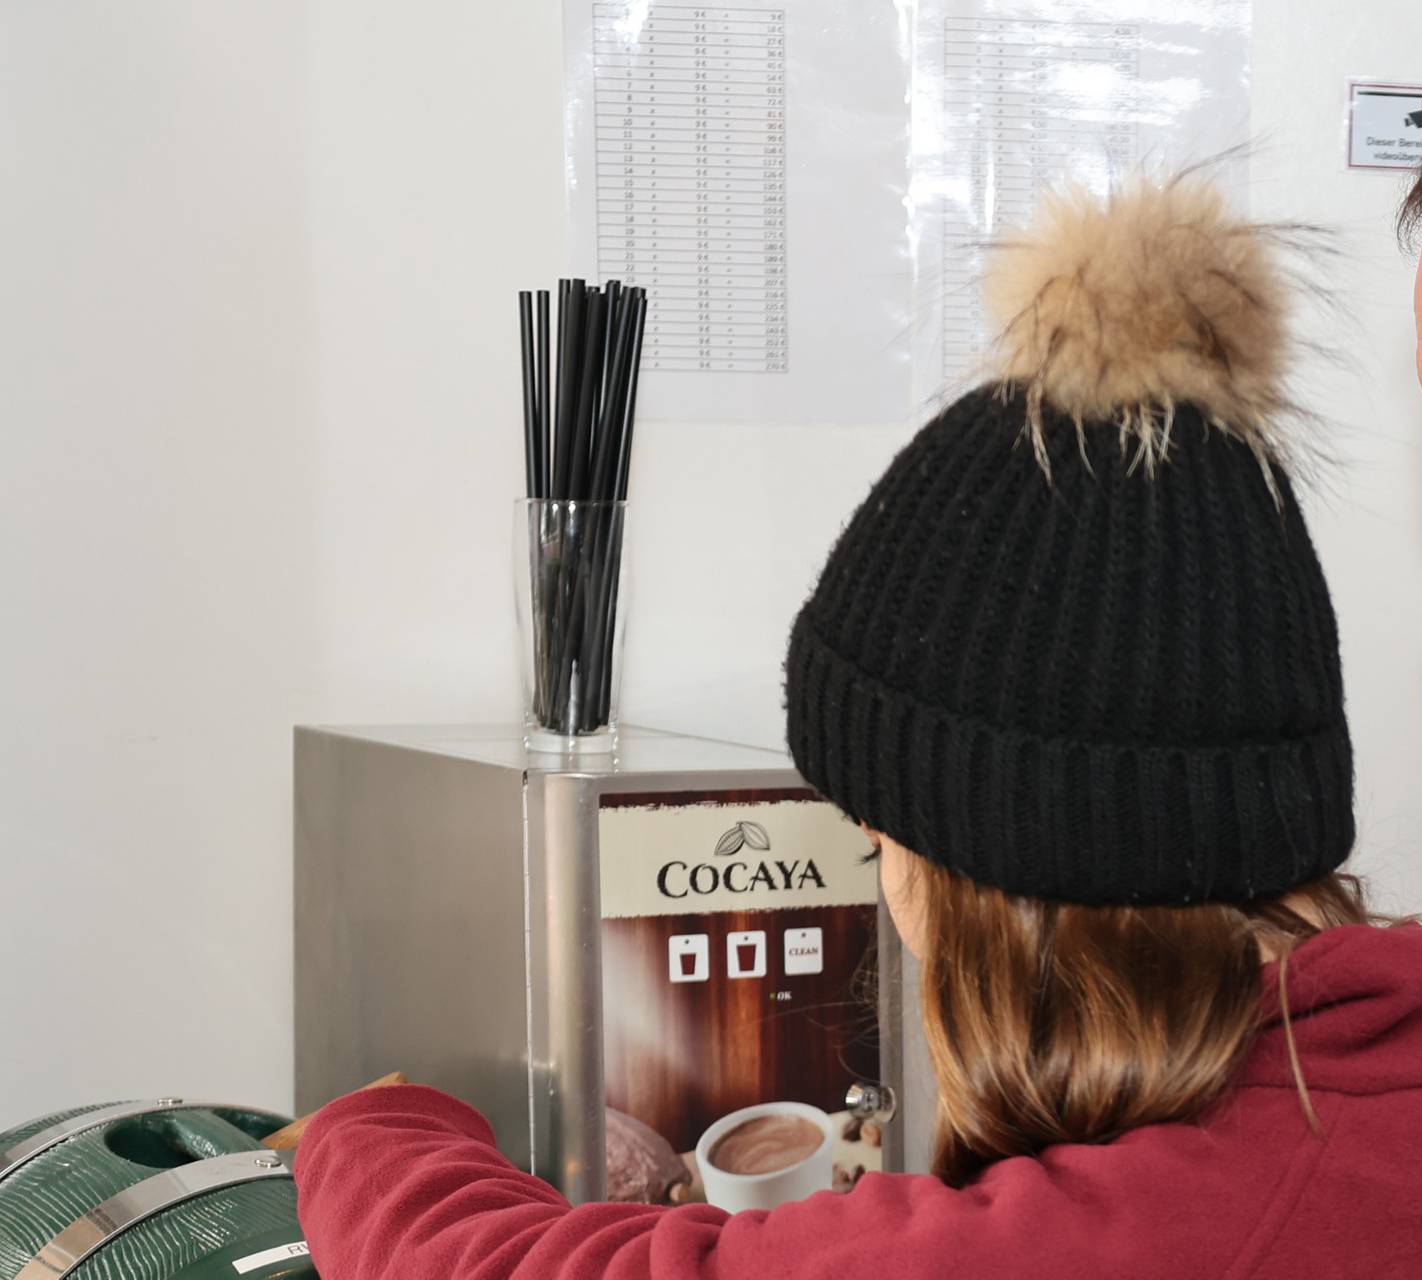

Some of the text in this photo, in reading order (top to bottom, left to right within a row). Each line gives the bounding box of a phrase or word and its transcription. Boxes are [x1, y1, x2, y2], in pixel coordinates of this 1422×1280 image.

[1366, 136, 1396, 146] Dieser
[657, 858, 827, 899] COCAYA
[788, 947, 818, 956] CLEAN
[777, 991, 792, 1000] OK
